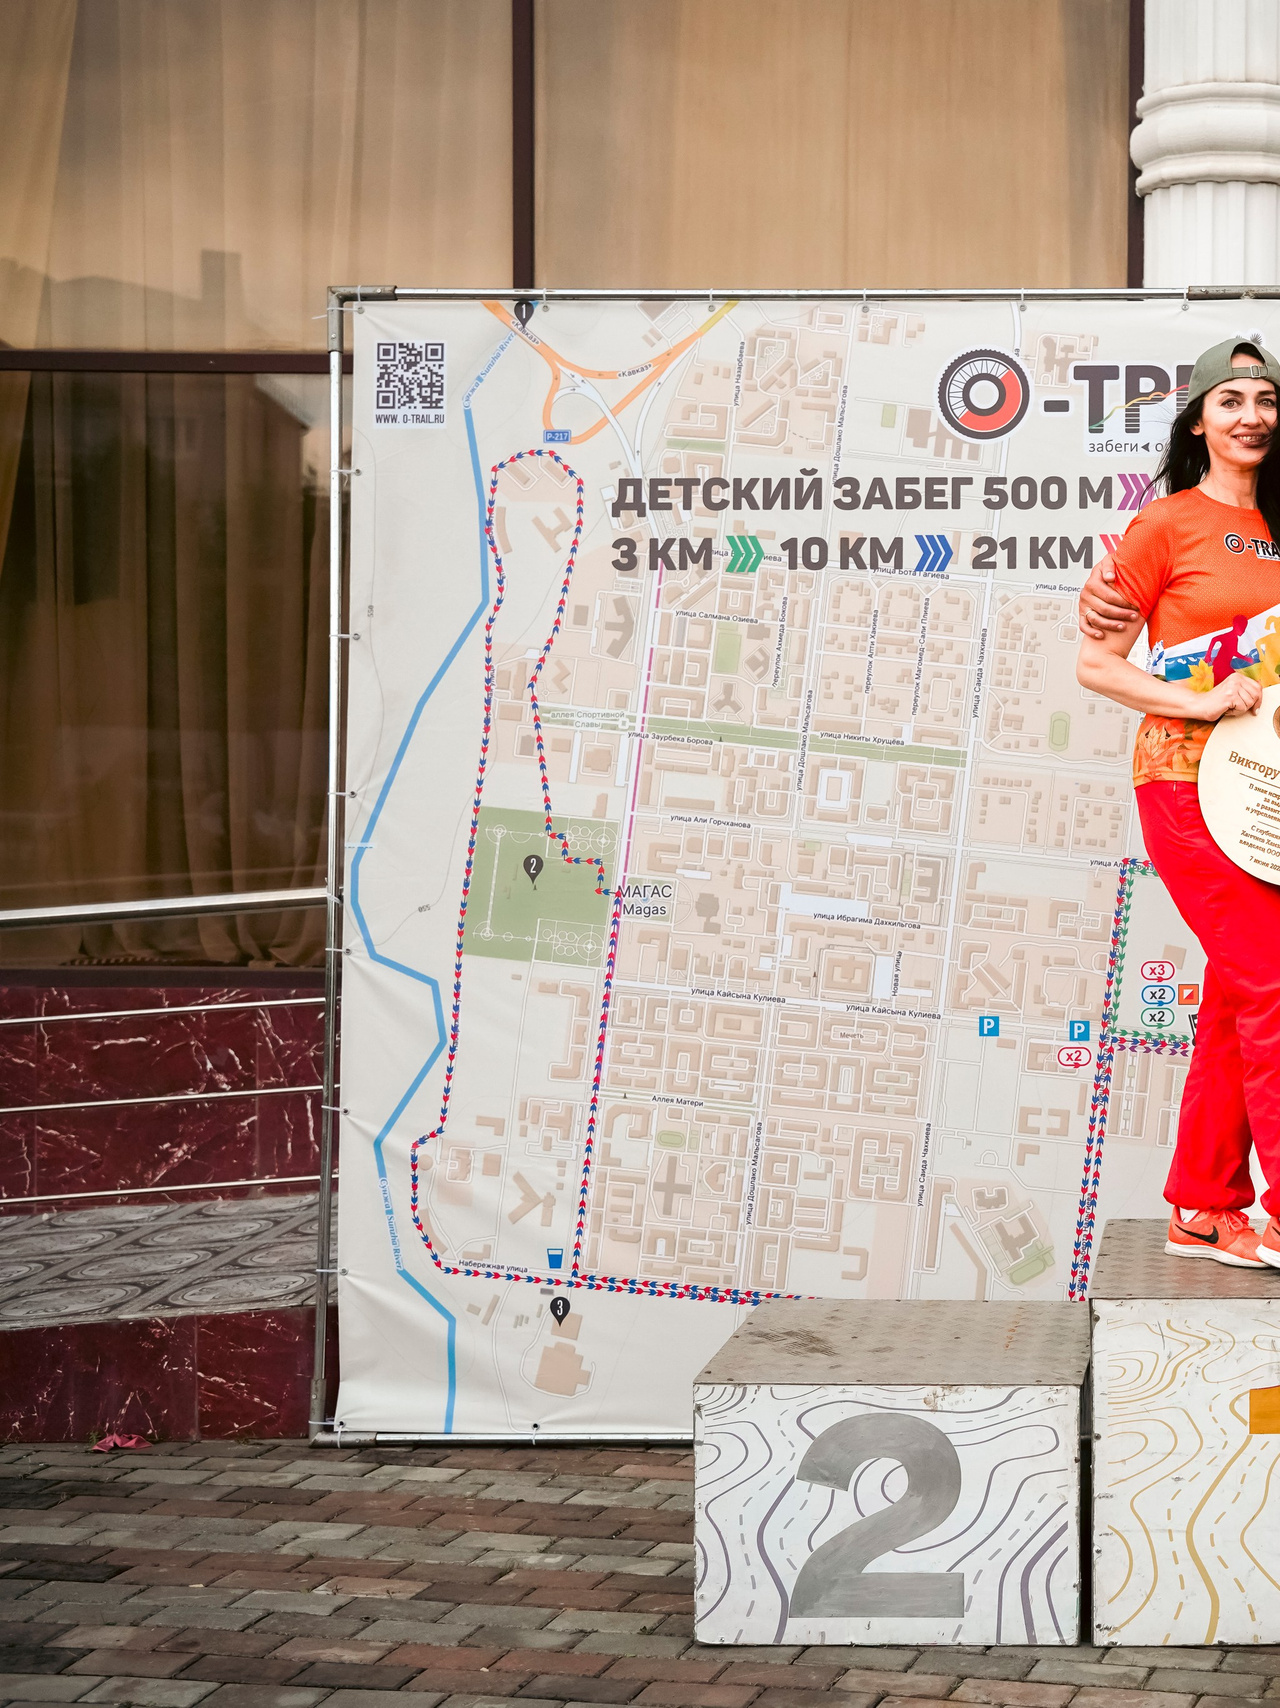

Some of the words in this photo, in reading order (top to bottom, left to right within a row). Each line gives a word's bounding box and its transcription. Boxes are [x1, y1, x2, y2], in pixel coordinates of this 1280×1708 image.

[521, 303, 526, 319] 1
[618, 362, 653, 378] «Кавказ»
[735, 341, 745, 384] Назарбаева
[733, 385, 741, 407] улица
[1088, 440, 1139, 453] забеги
[611, 467, 822, 518] ДЕТСКИЙ
[833, 476, 974, 511] ЗАБЕГ
[982, 476, 1068, 511] 500
[1078, 476, 1113, 510] М
[611, 537, 637, 571] 3
[648, 537, 713, 571] КМ
[780, 536, 829, 571] 10
[839, 536, 904, 571] КМ
[971, 535, 1017, 570] 21
[1029, 535, 1093, 570] КМ
[675, 610, 697, 618] улица
[698, 611, 731, 621] Салмана
[732, 614, 759, 624] Озиева
[779, 596, 788, 622] Бокова
[922, 597, 931, 622] Плиева
[776, 624, 785, 652] Ахмеда
[978, 627, 988, 667] Чахкиева
[915, 623, 927, 681] Магомед-Сали
[975, 667, 984, 694] Саида
[911, 681, 921, 716] переулок
[972, 695, 980, 719] улица
[802, 690, 813, 733] Мальсагова
[627, 730, 650, 739] улица
[651, 732, 685, 743] Заурбека
[686, 736, 714, 746] Борова
[820, 731, 842, 740] улица
[843, 733, 871, 743] Никиты
[872, 735, 905, 746] Хрущёва
[798, 734, 808, 769] Дошлако
[796, 769, 804, 792] улица
[670, 815, 692, 823] улица
[693, 816, 708, 824] Али
[708, 818, 751, 829] Горчханова
[529, 858, 537, 874] 2
[618, 885, 672, 899] МАГАС
[622, 904, 667, 917] Magas
[813, 911, 835, 921] улица
[836, 914, 873, 925] Ибрагима
[874, 918, 921, 930] Дахкильгова
[894, 950, 903, 973] улица
[1149, 964, 1165, 976] x3
[891, 973, 900, 997] Новая
[1149, 988, 1166, 1000] x2
[691, 987, 715, 997] улица
[716, 990, 751, 1000] Кайсына
[753, 994, 786, 1004] Кулиева
[1149, 1011, 1165, 1023] x2
[839, 1032, 865, 1040] Мечеть
[1065, 1050, 1082, 1062] x2
[652, 1095, 674, 1104] Аллея
[675, 1097, 704, 1107] Матери
[458, 1259, 505, 1270] Набережная
[506, 1265, 528, 1274] улица
[556, 1300, 564, 1316] 3
[788, 1410, 966, 1619] 2
